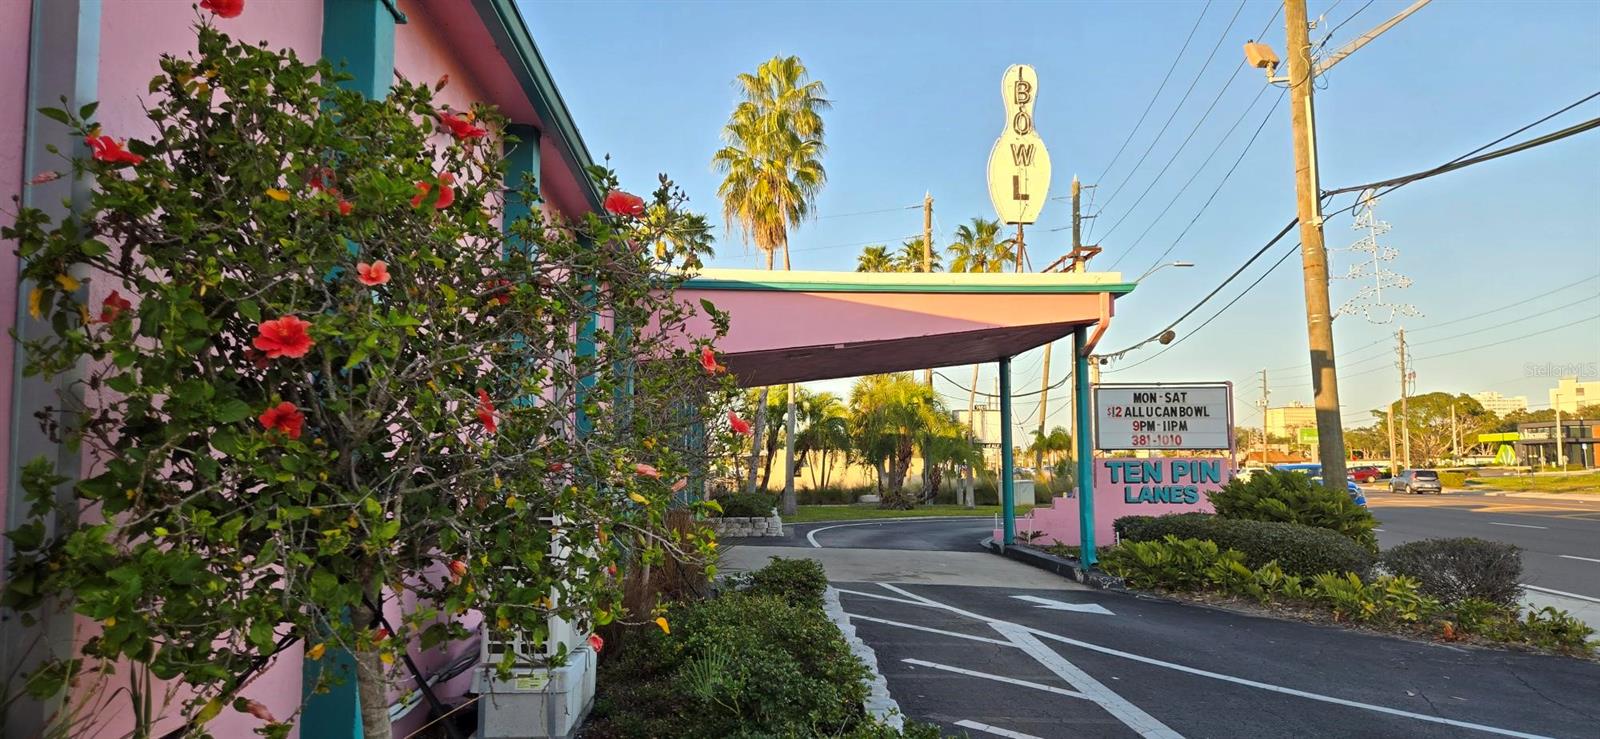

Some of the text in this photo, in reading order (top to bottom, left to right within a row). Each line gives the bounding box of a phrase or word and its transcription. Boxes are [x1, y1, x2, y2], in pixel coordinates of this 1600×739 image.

[1010, 80, 1035, 200] BOWL
[1107, 406, 1122, 418] $12
[1131, 435, 1182, 446] 381-1010
[1104, 460, 1221, 484] TEN PIN
[1124, 485, 1200, 504] LANES
